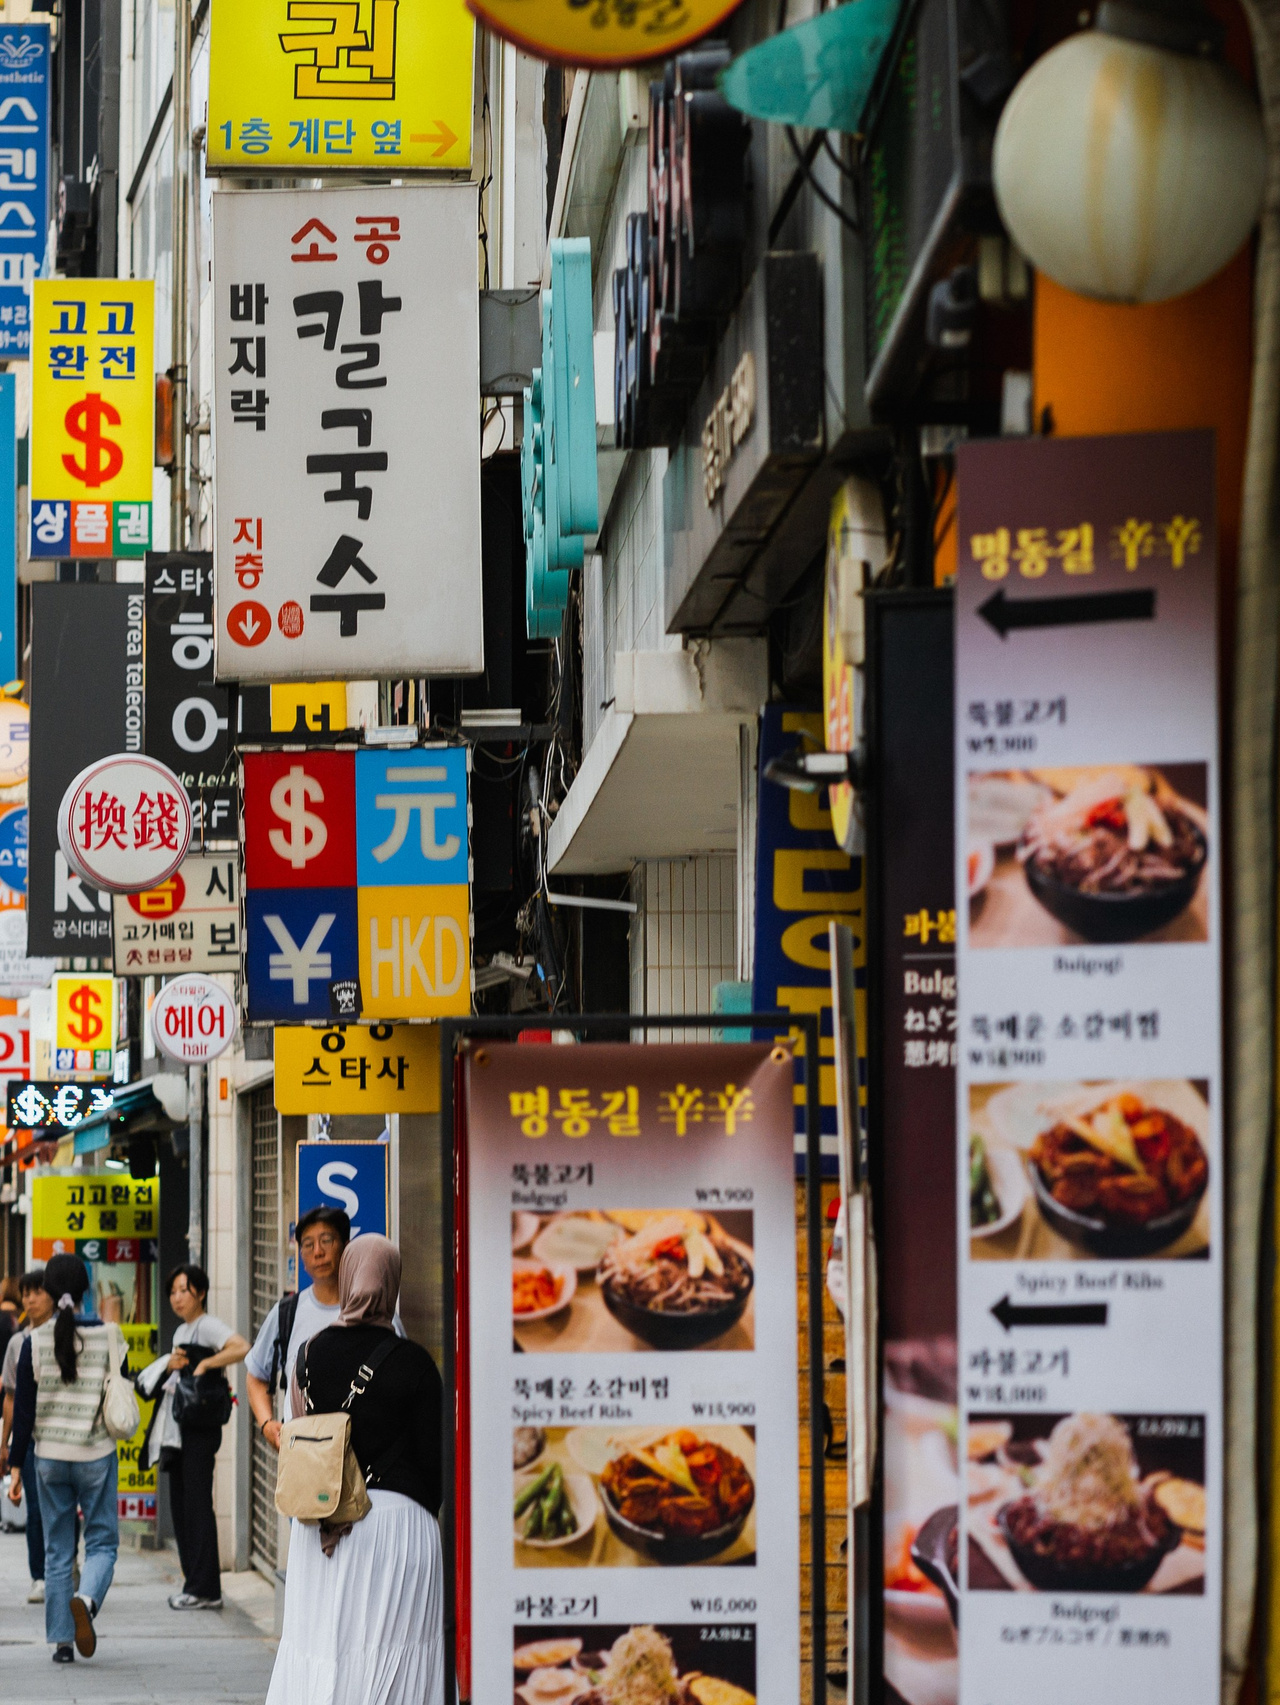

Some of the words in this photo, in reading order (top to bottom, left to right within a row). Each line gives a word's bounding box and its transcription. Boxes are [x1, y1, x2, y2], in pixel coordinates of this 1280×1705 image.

[220, 120, 273, 154] 1층
[288, 120, 356, 155] 계단
[371, 119, 402, 155] 옆
[291, 215, 401, 264] 소공
[48, 300, 136, 336] 고고
[47, 345, 136, 380] 환전
[227, 282, 270, 431] 바지락
[60, 392, 124, 488] $
[292, 280, 402, 637] 칼국수
[32, 502, 150, 544] 상품권
[232, 517, 264, 590] 지층
[970, 523, 1095, 580] 명동길
[126, 594, 144, 657] korea
[125, 661, 144, 752] telecom
[79, 790, 181, 853] 換錢
[191, 799, 230, 829] 2F
[268, 765, 328, 869] $
[371, 767, 461, 864] 元
[122, 920, 194, 942] 고가매입
[263, 914, 336, 1003] ¥
[370, 915, 464, 998] HKD
[67, 984, 103, 1043] $
[164, 1004, 225, 1039] 헤어
[182, 1042, 209, 1056] hair
[508, 1085, 641, 1139] 명동길
[66, 1185, 152, 1206] 고고환전
[511, 1191, 568, 1206] Bulgogi
[511, 1404, 554, 1421] Spicy
[559, 1403, 594, 1418] Beef
[600, 1402, 632, 1418] Ribs
